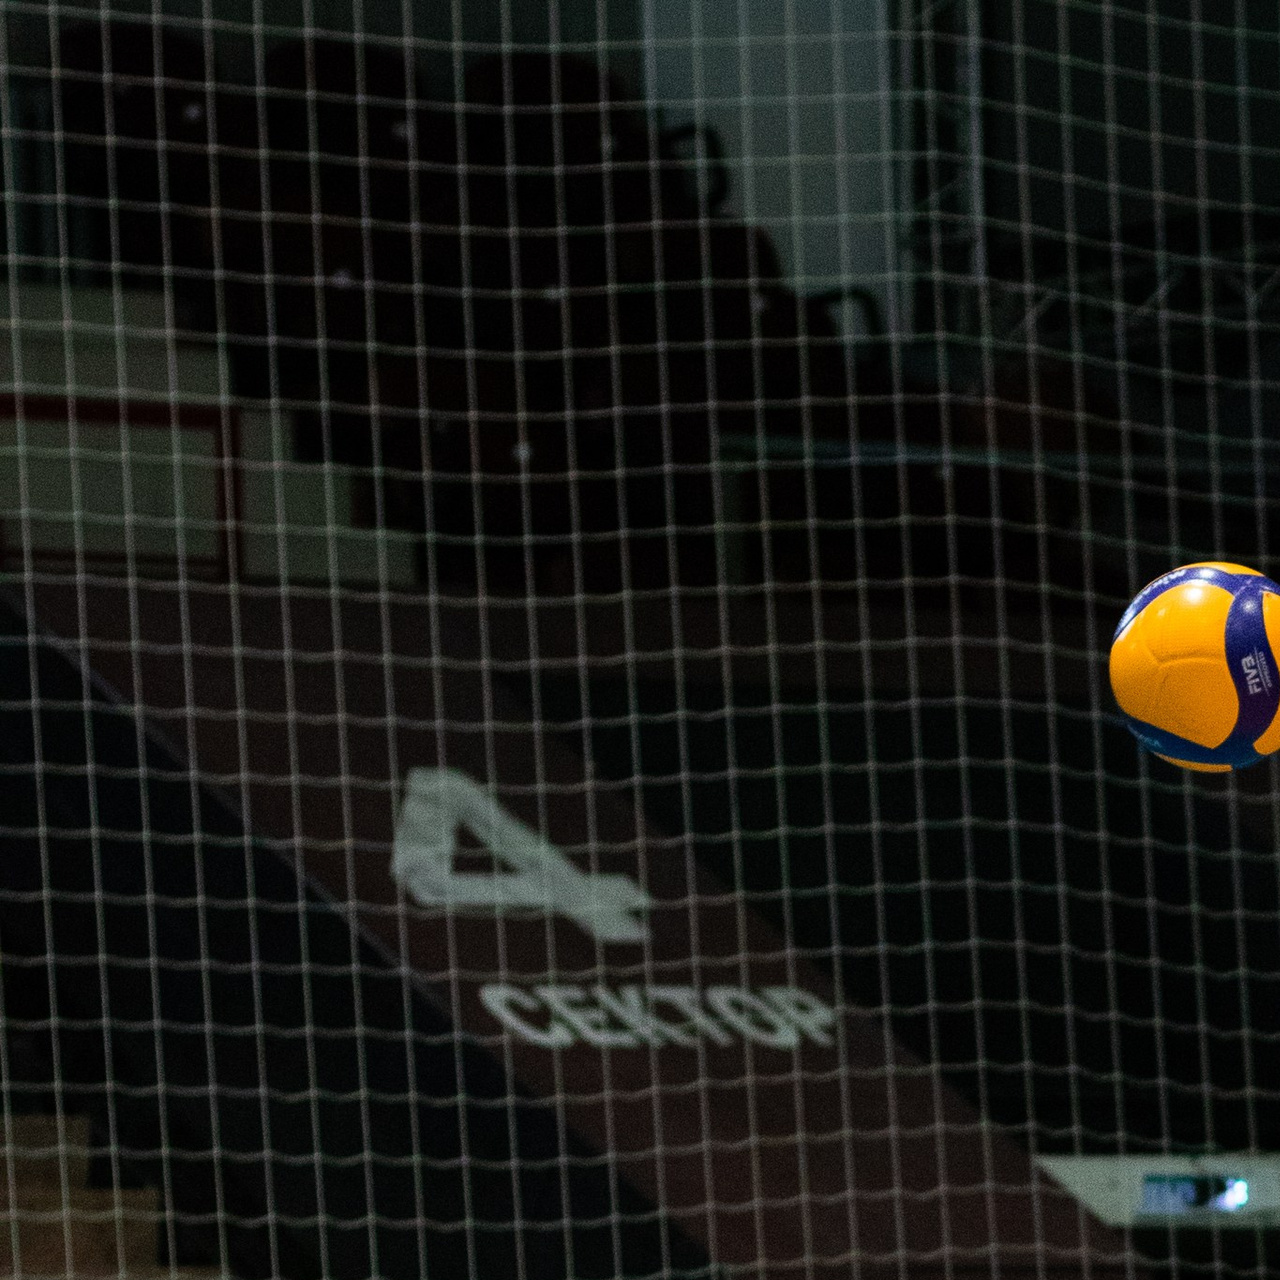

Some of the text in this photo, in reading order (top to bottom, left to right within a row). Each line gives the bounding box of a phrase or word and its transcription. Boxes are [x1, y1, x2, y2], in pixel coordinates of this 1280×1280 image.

[1241, 653, 1262, 695] FIVB
[391, 767, 649, 942] 4
[480, 984, 834, 1048] СЕКТОР
